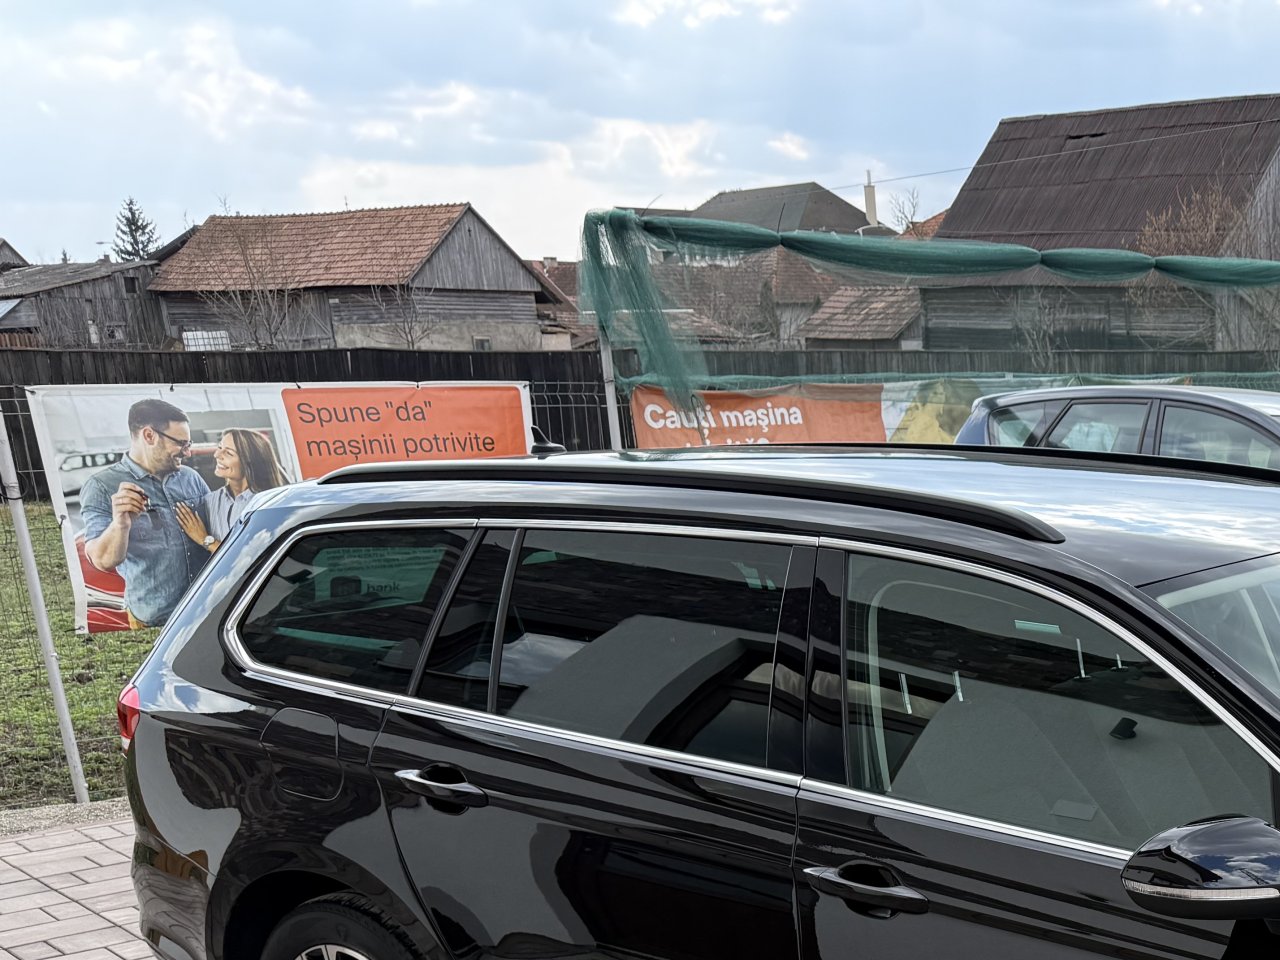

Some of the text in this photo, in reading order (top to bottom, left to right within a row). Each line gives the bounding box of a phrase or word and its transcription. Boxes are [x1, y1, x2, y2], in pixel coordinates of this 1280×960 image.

[297, 401, 432, 427] Spune "da"
[306, 431, 495, 460] mașinii potrivite
